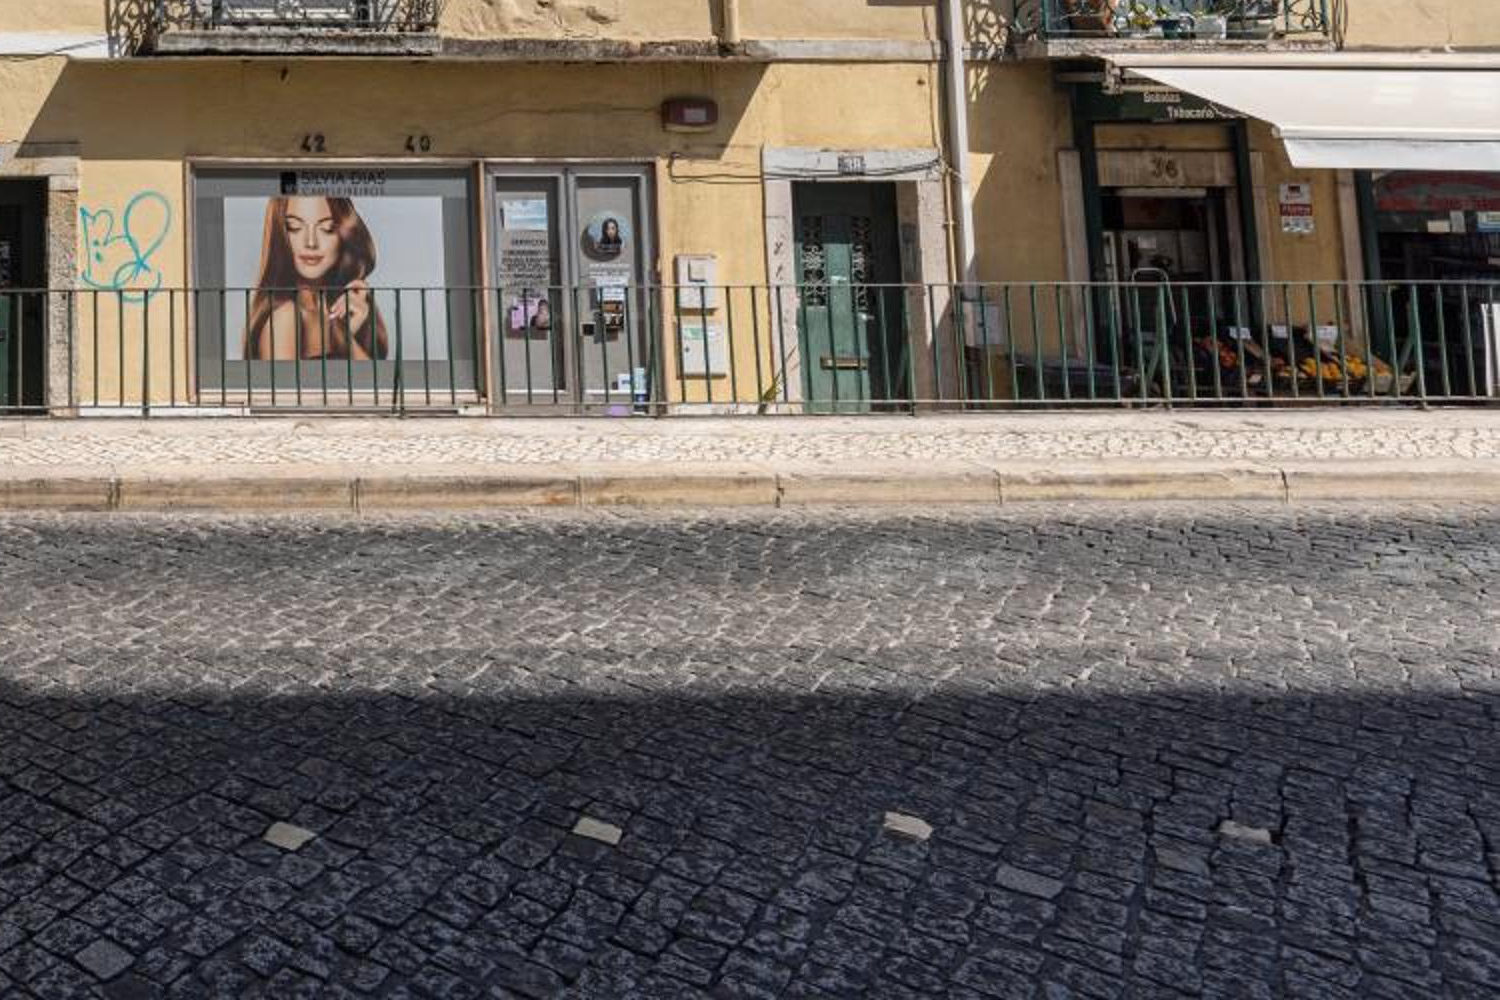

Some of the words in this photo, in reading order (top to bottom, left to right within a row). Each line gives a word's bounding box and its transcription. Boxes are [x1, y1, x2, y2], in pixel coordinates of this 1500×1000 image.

[301, 134, 326, 152] 42
[405, 135, 431, 152] 40
[1150, 158, 1179, 178] 36
